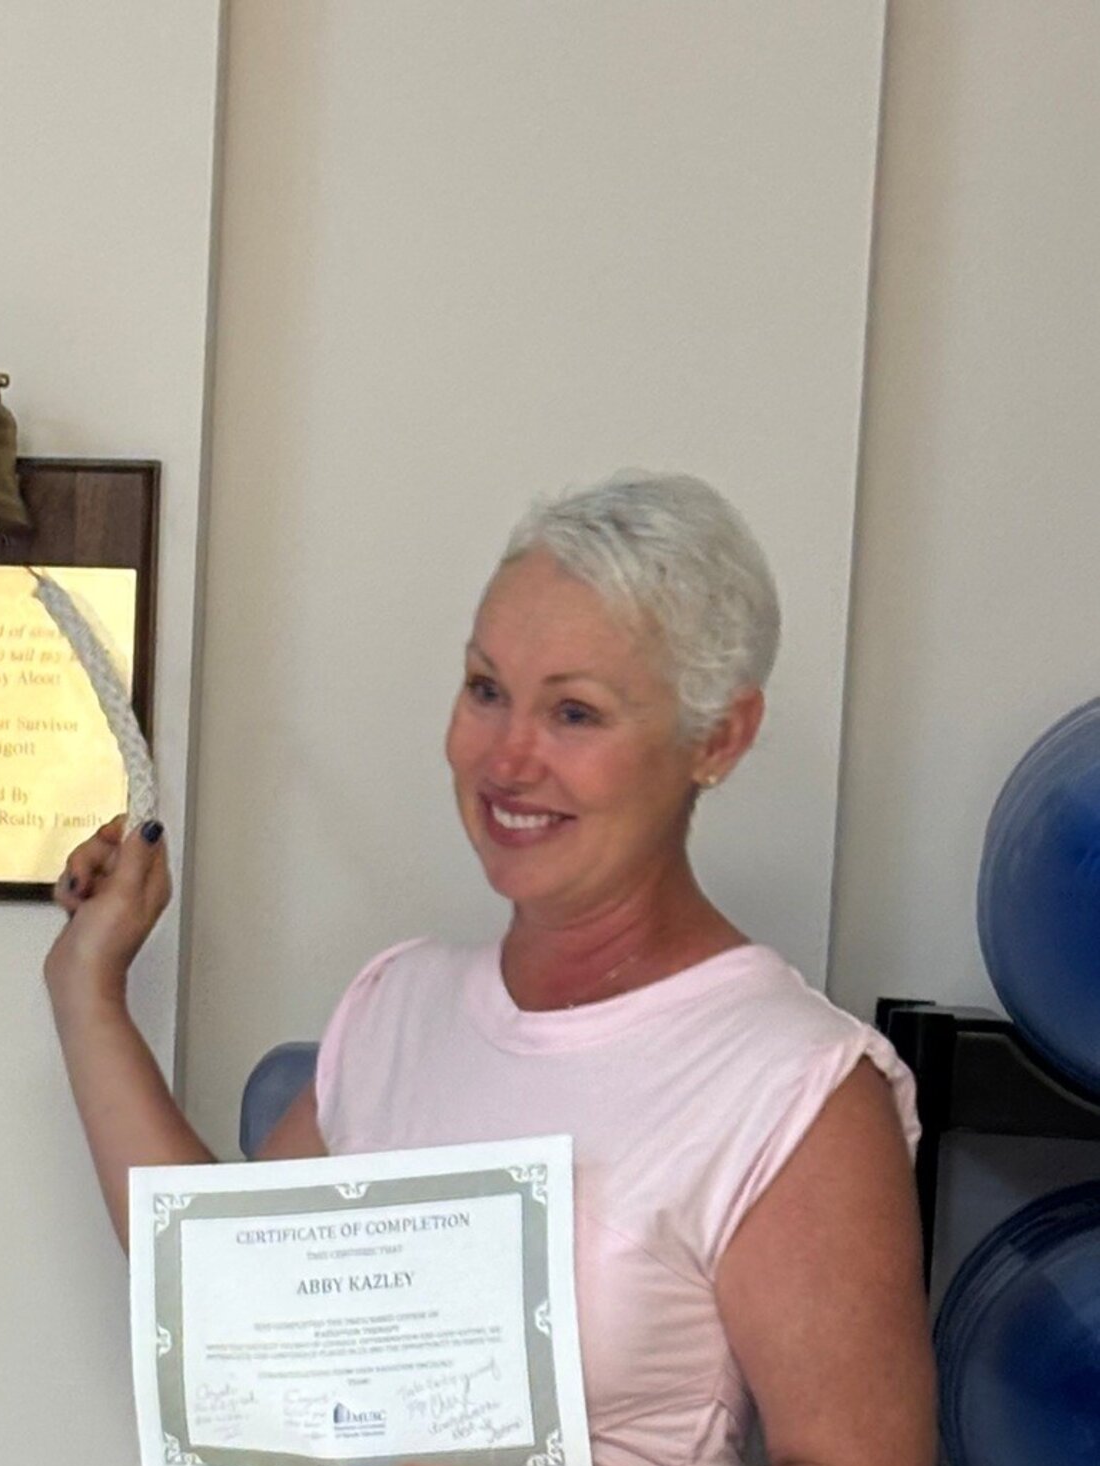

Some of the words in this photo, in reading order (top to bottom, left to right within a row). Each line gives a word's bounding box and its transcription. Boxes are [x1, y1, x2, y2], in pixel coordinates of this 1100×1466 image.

[17, 716, 79, 732] Survivor
[12, 787, 30, 804] By
[0, 809, 46, 829] Realty
[236, 1226, 337, 1245] CERTIFICATE
[340, 1222, 361, 1239] OF
[366, 1212, 471, 1235] COMPLETION
[297, 1277, 345, 1296] ABBY
[349, 1271, 415, 1292] KAZLEY
